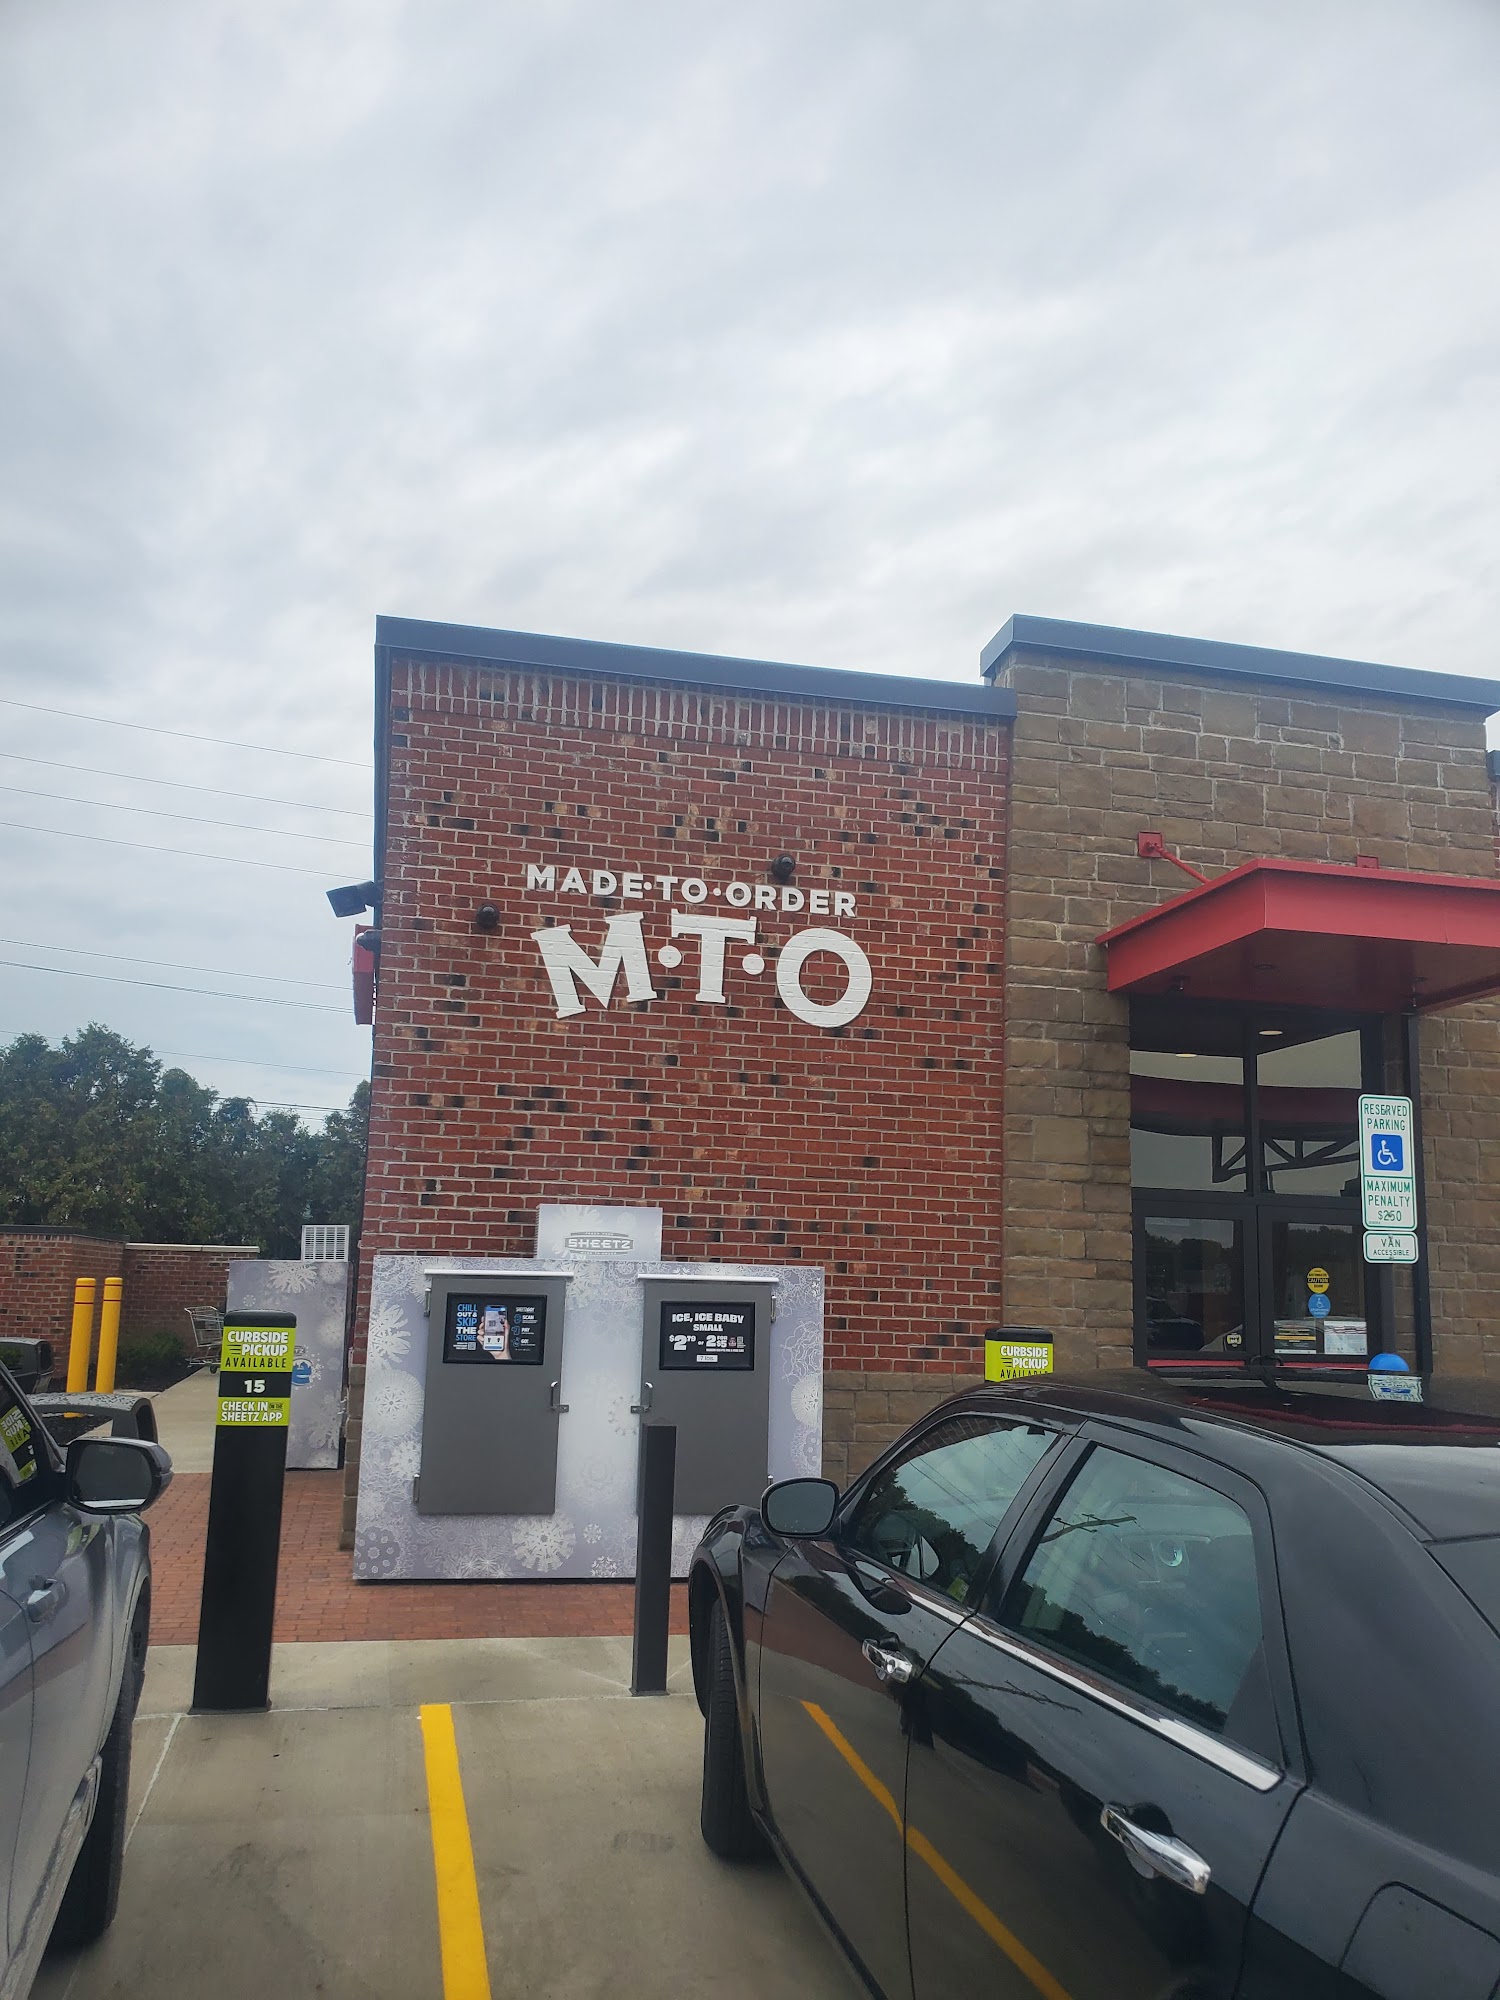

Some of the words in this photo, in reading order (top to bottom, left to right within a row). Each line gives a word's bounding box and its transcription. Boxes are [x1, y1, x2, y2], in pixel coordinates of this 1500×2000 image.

[1364, 1103, 1408, 1117] RESERVED
[1367, 1118, 1406, 1131] PARKING
[1366, 1180, 1411, 1193] MAXIMUM
[1368, 1195, 1410, 1207] PENALTY
[1377, 1210, 1402, 1221] $250
[568, 1239, 631, 1249] SHEETZ
[1381, 1238, 1401, 1247] VAN
[457, 1303, 478, 1312] CHILL
[456, 1318, 477, 1326] SKIP
[671, 1313, 693, 1322] ICE,
[694, 1313, 713, 1321] ICE
[714, 1313, 744, 1323] BABY
[456, 1327, 477, 1335] THE
[693, 1323, 723, 1331] SMALL
[227, 1330, 289, 1343] CURBSIDE
[241, 1344, 288, 1356] PICKUP
[1000, 1345, 1048, 1357] CURBSIDE
[225, 1357, 286, 1367] AVAILABLE
[1012, 1357, 1049, 1369] PICKUP
[244, 1379, 266, 1393] 15
[221, 1401, 255, 1411] CHECK
[257, 1401, 268, 1411] IN
[221, 1411, 260, 1421] SHEETZ
[261, 1412, 283, 1422] APP
